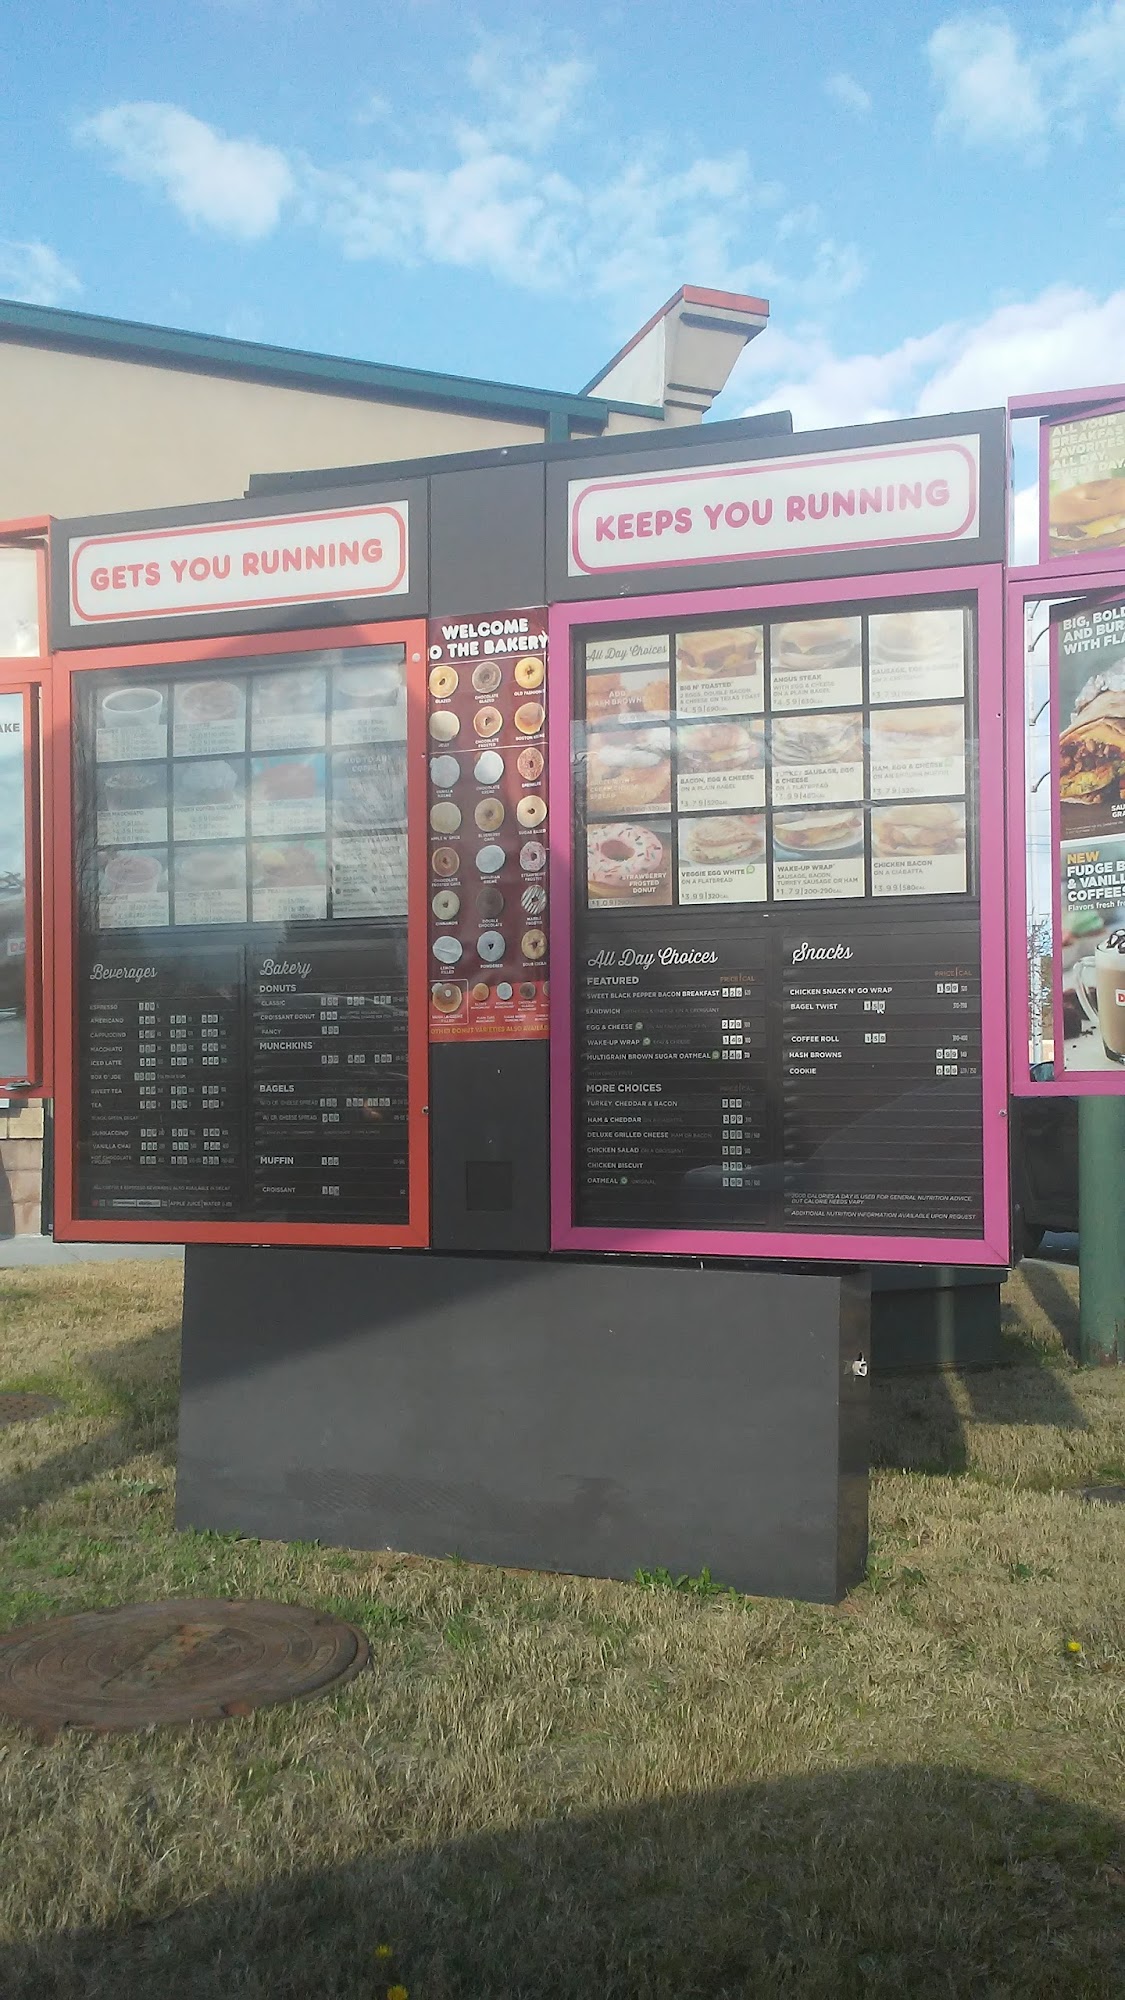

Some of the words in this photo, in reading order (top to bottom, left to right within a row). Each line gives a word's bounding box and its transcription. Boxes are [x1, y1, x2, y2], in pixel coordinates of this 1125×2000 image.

[1052, 425, 1077, 436] ALL
[1080, 415, 1117, 430] YOUR
[1053, 436, 1124, 458] FAVORITES
[1053, 458, 1076, 468] ALL
[596, 508, 693, 541] KEEPS
[703, 499, 773, 530] YOU
[787, 480, 950, 522] RUNNING
[90, 562, 160, 591] GETS
[171, 555, 231, 583] YOU
[242, 539, 383, 576] RUNNING
[442, 619, 528, 640] WELCOME
[1063, 616, 1089, 630] BIG,
[1064, 628, 1092, 643] AND
[447, 641, 479, 658] THE
[484, 634, 547, 654] BAKERY
[586, 649, 603, 661] All
[605, 647, 627, 660] Day
[630, 645, 666, 657] Choices
[1064, 638, 1100, 655] WITH
[1067, 851, 1099, 864] NEW
[1067, 862, 1112, 877] FUDGE
[1067, 879, 1076, 889] &
[1068, 903, 1094, 911] Flavors
[588, 950, 615, 968] All
[618, 948, 655, 970] Day
[659, 947, 718, 966] Choices
[792, 942, 853, 964] Snacks
[90, 964, 157, 983] Beverages
[260, 959, 312, 979] Bakery
[587, 976, 639, 985] FEATURED
[259, 1042, 313, 1050] MUNCHKINS
[587, 1084, 615, 1092] MORE
[618, 1084, 662, 1092] CHOICES
